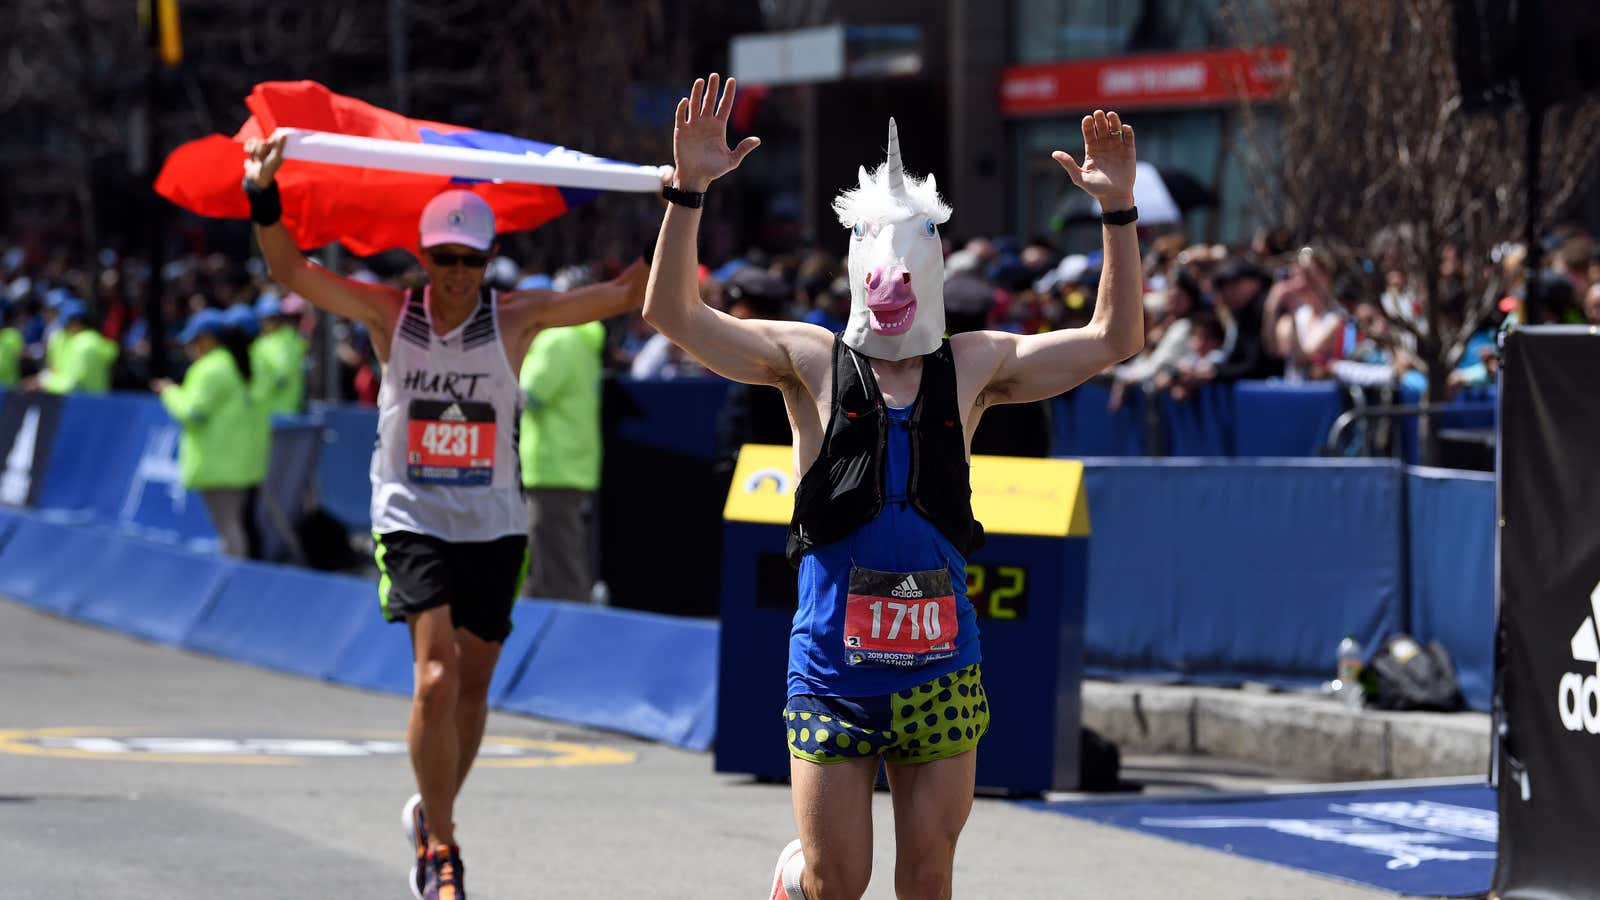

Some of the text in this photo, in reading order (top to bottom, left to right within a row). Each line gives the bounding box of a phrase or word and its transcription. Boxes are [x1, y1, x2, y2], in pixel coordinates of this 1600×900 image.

[421, 422, 479, 457] 4231
[891, 588, 923, 598] adidas
[869, 600, 942, 640] 1710
[848, 637, 859, 647] 2
[867, 652, 883, 660] 2019
[867, 658, 913, 666] RATHON
